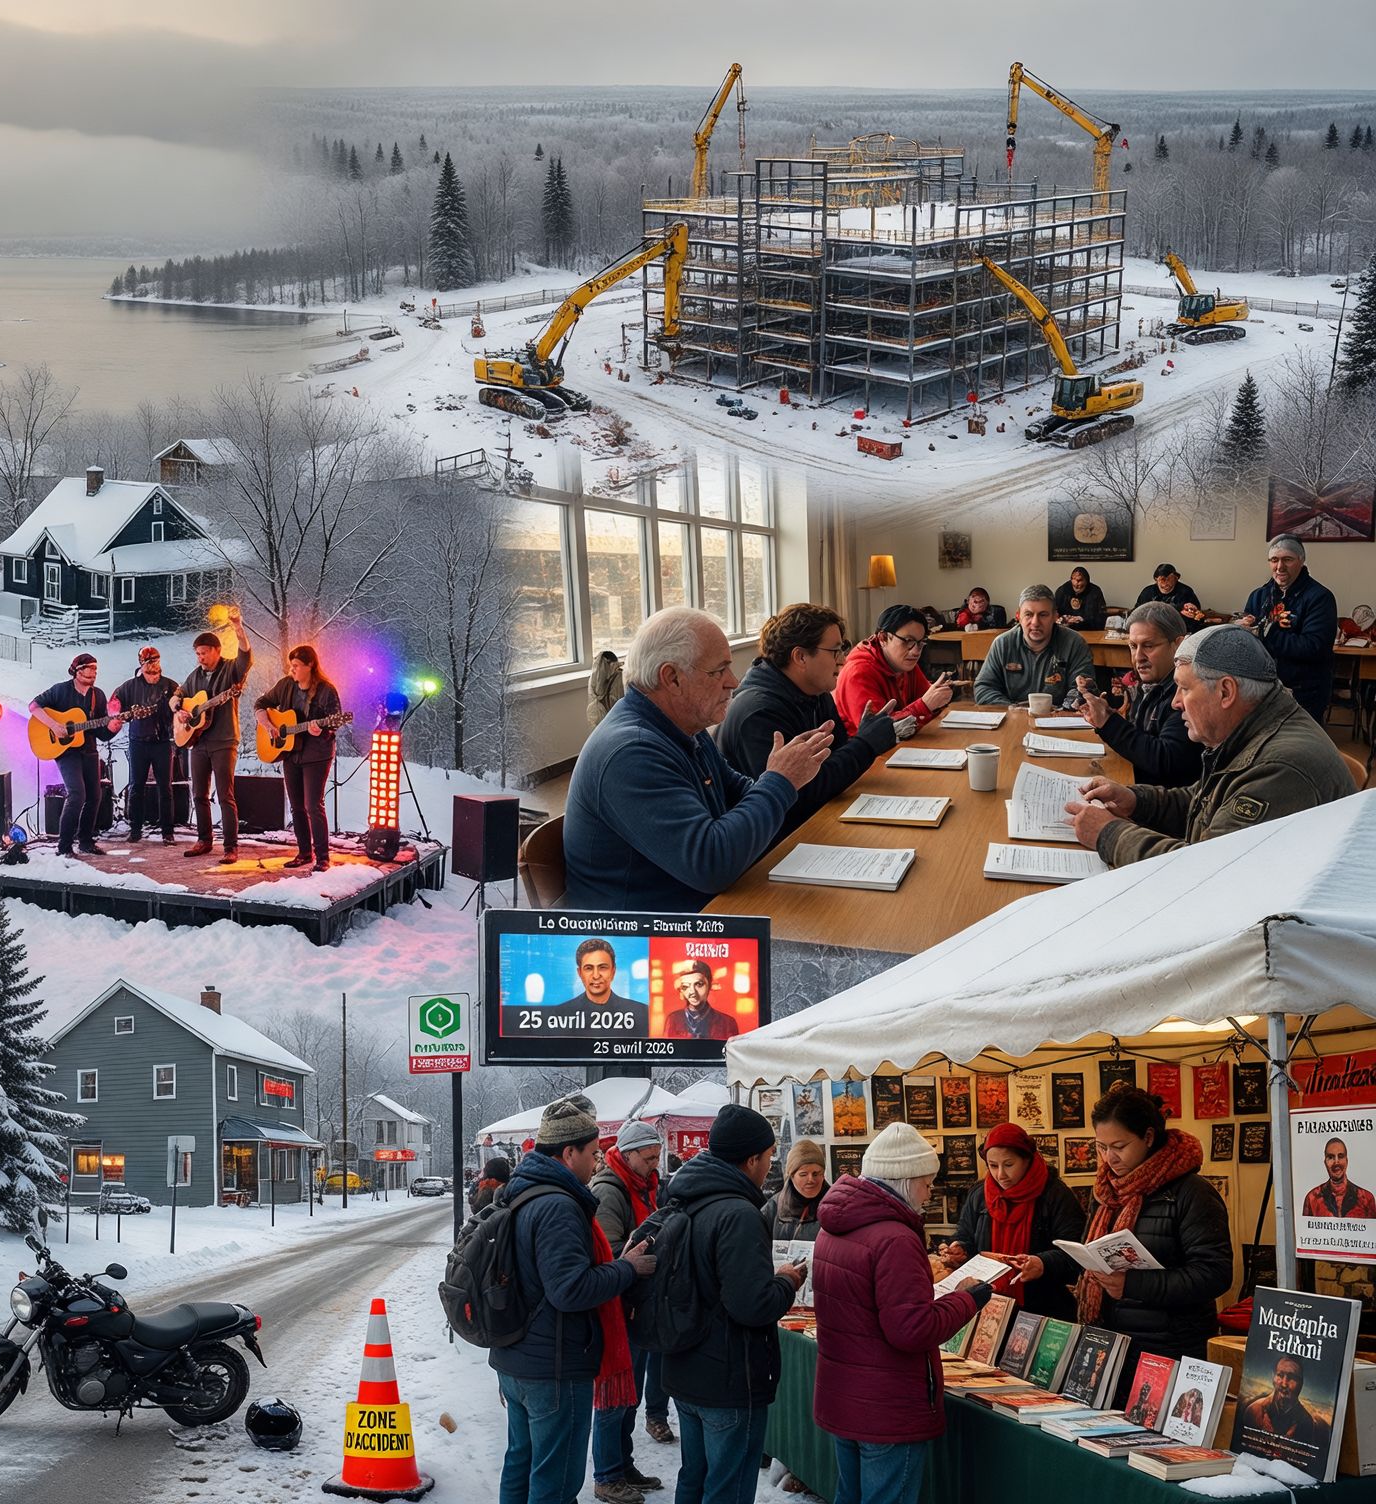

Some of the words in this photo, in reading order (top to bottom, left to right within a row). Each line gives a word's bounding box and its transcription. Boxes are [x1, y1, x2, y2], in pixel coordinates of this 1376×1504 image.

[519, 1011, 543, 1029] 25
[547, 1011, 586, 1029] avril
[590, 1012, 635, 1030] 2026
[593, 1041, 610, 1054] 25
[645, 1042, 674, 1055] 2026
[1258, 1305, 1338, 1339] Mustapha
[358, 1410, 397, 1429] ZONE
[345, 1431, 410, 1452] D'ACCIDENT
